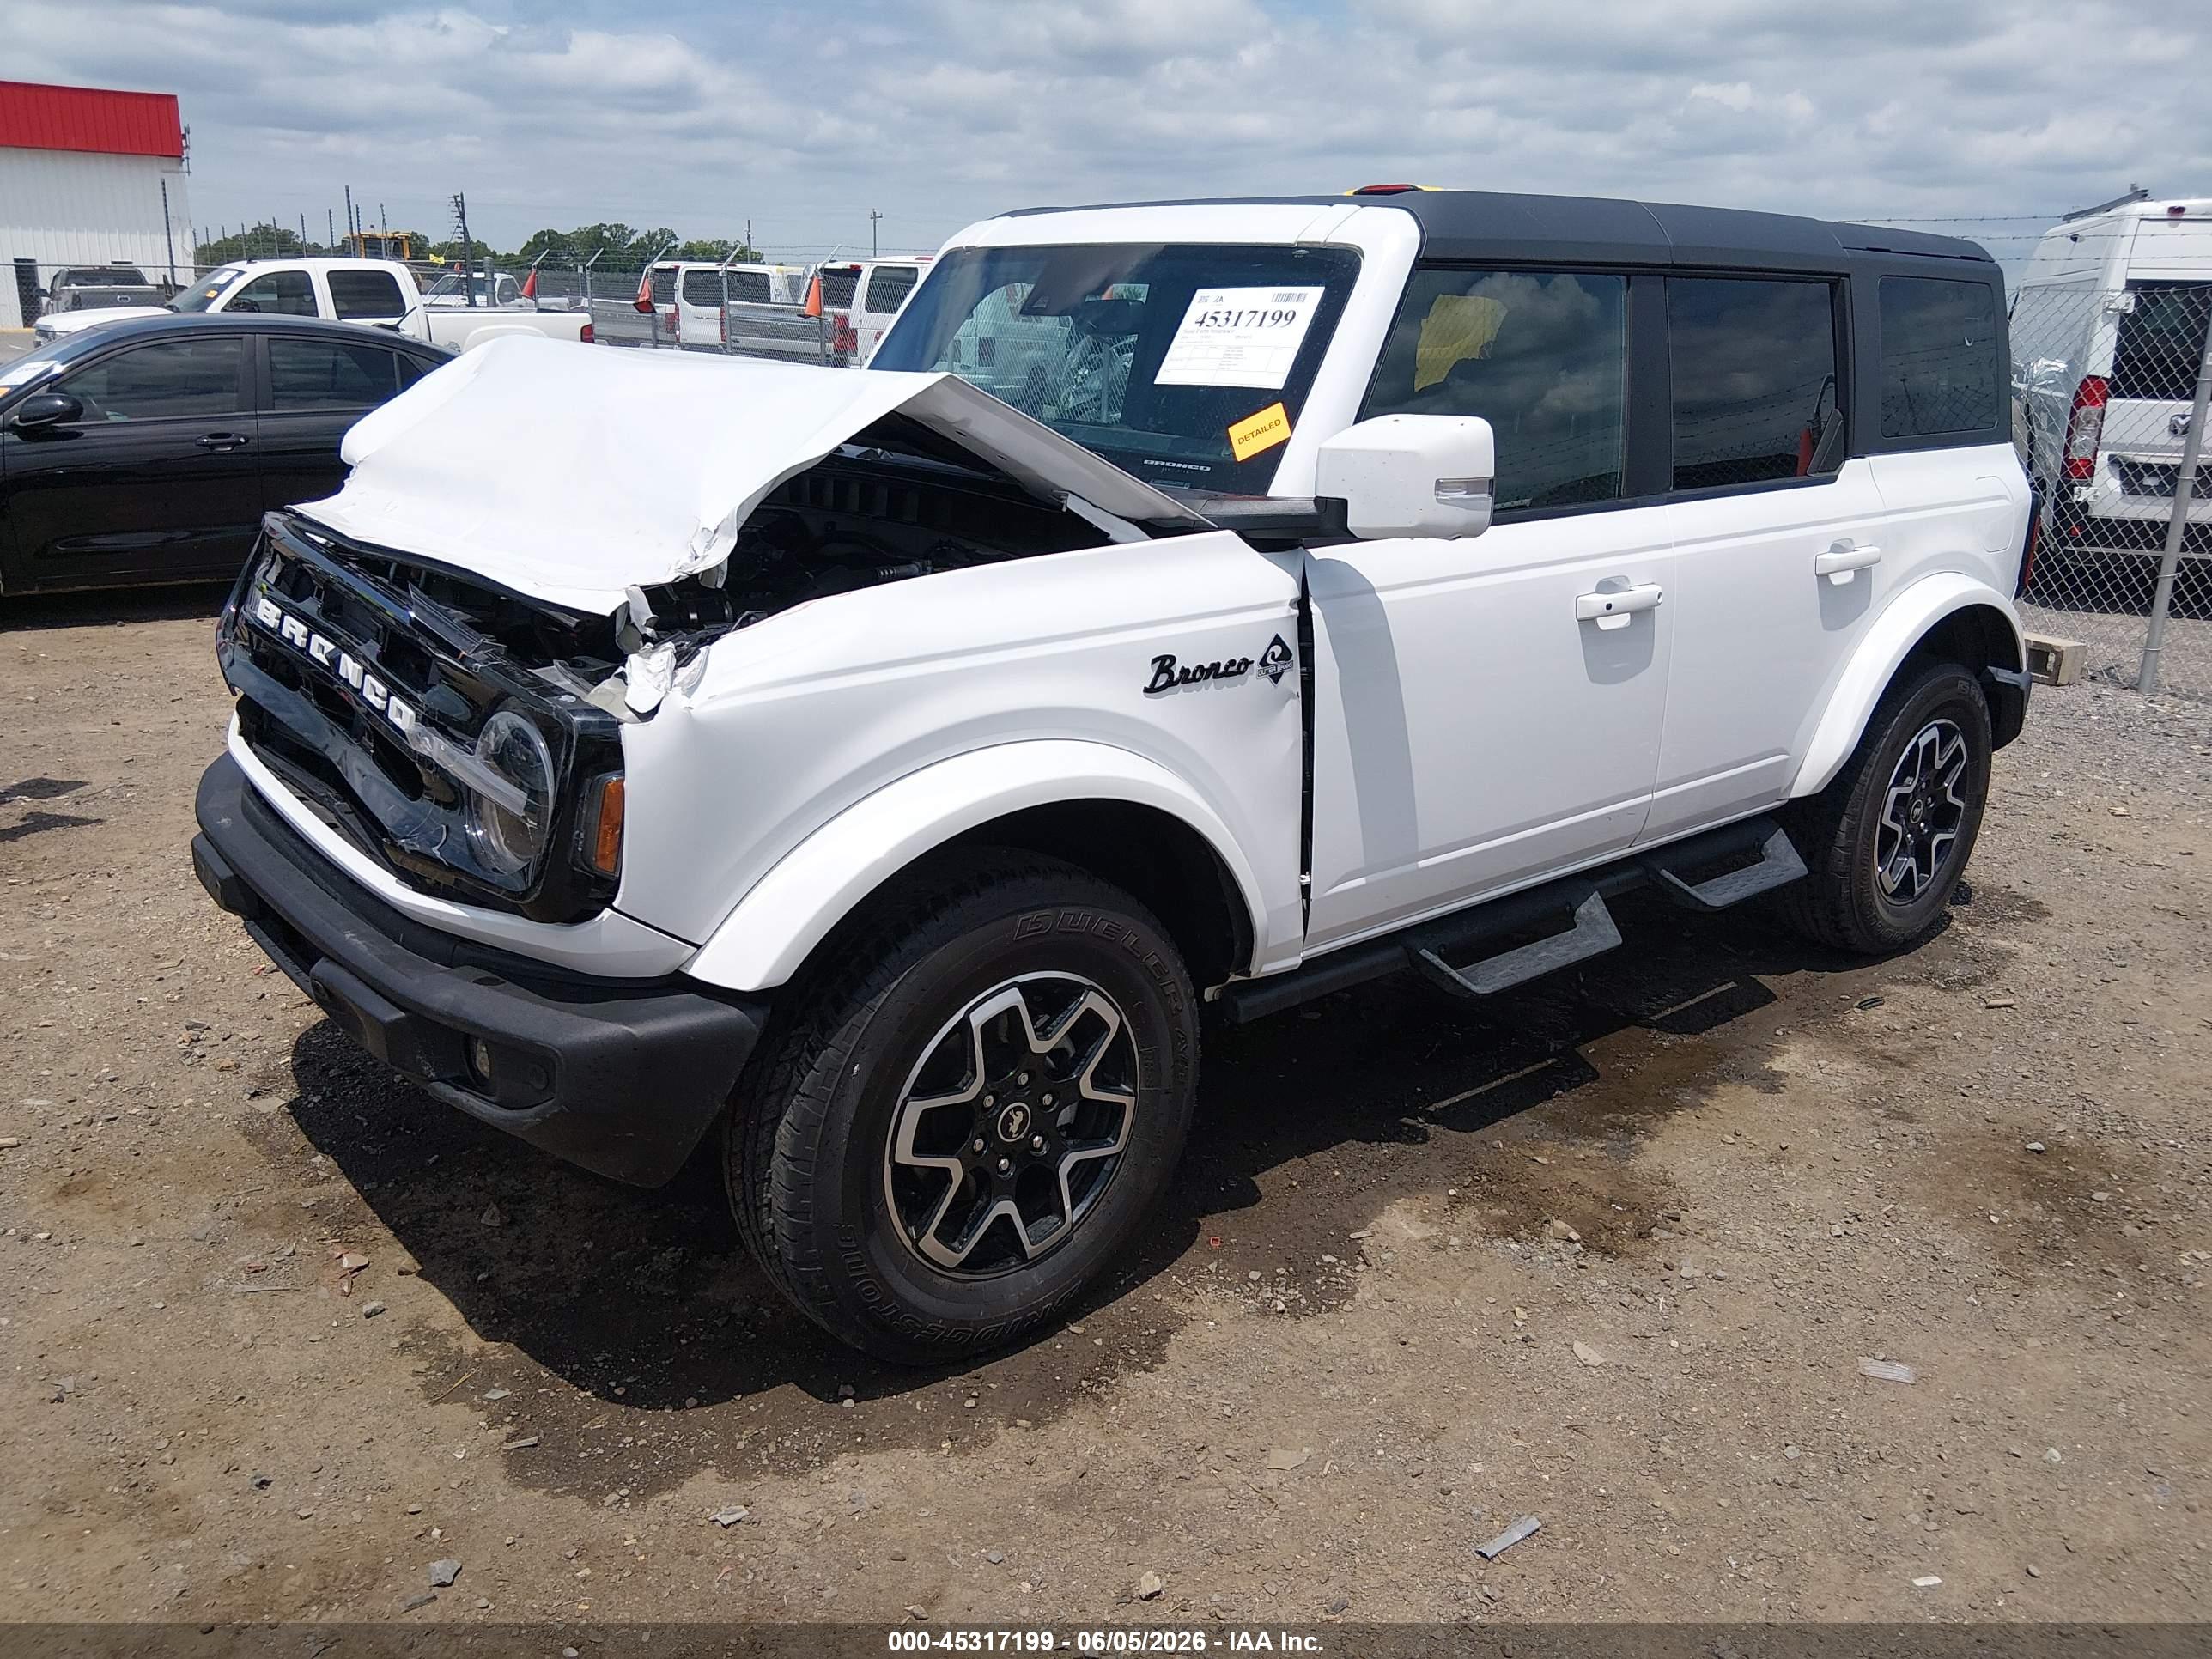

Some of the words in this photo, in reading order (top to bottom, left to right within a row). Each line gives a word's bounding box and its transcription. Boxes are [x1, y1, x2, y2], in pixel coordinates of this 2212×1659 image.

[1194, 309, 1297, 328] 45317199
[1237, 418, 1281, 445] DETAILED
[1143, 459, 1212, 471] BRONCO
[1142, 654, 1255, 694] Bronco
[1258, 665, 1277, 677] OUTER
[1013, 907, 1183, 1017] DUELER
